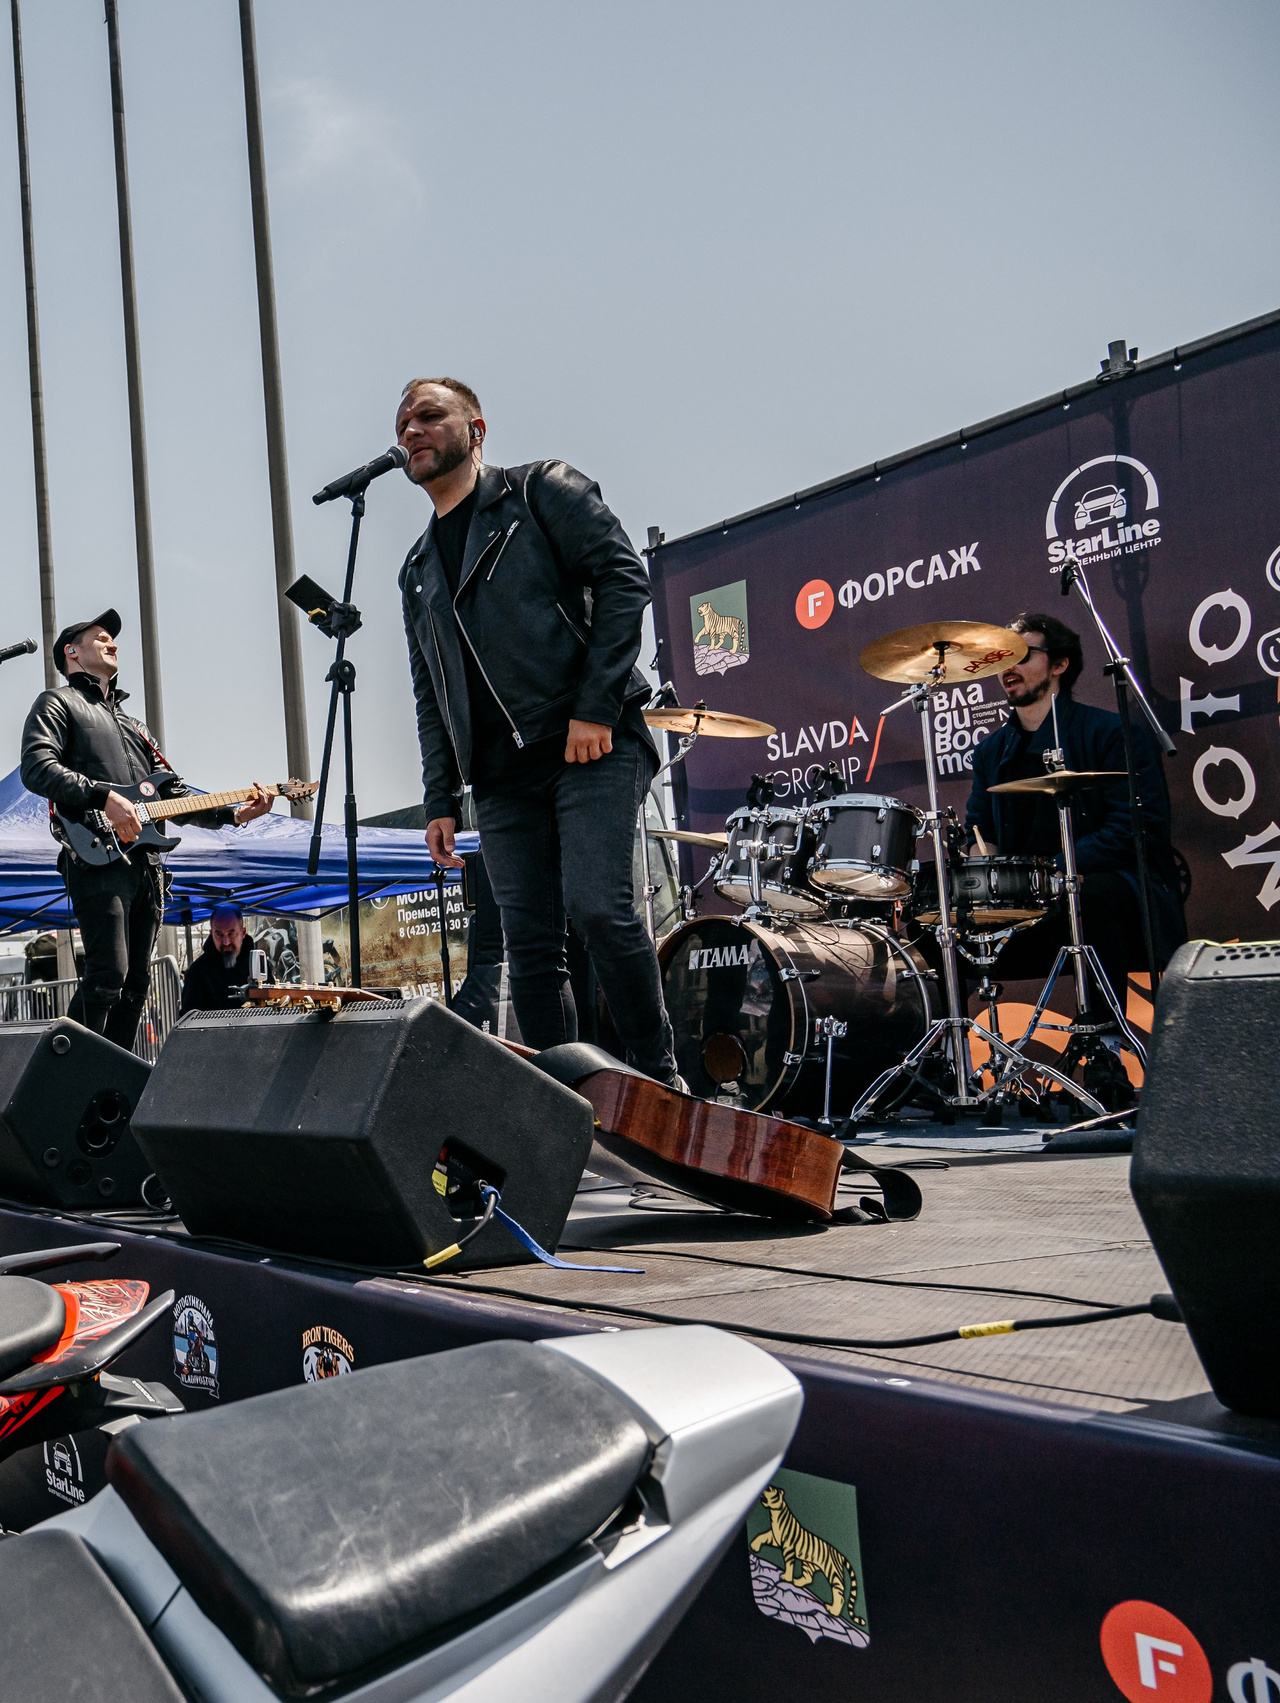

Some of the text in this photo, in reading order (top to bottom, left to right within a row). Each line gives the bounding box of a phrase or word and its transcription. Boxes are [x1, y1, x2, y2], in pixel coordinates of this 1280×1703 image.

[1047, 518, 1161, 564] StarLine
[1049, 537, 1162, 574] ФИЕННЫЙ ЦЕНТР
[838, 541, 982, 609] ФОРСАЖ
[766, 715, 870, 762] SLAVDA
[396, 884, 463, 906] MOTORA
[399, 927, 405, 938] 8
[406, 924, 430, 938] (423)
[431, 921, 448, 933] 23
[449, 919, 461, 930] 30
[700, 944, 750, 969] TAMA
[414, 982, 439, 1000] LIFE
[302, 1326, 355, 1363] IRON TIGERS
[180, 1374, 216, 1388] VLADIVOSTOK
[45, 1468, 86, 1503] StarLine
